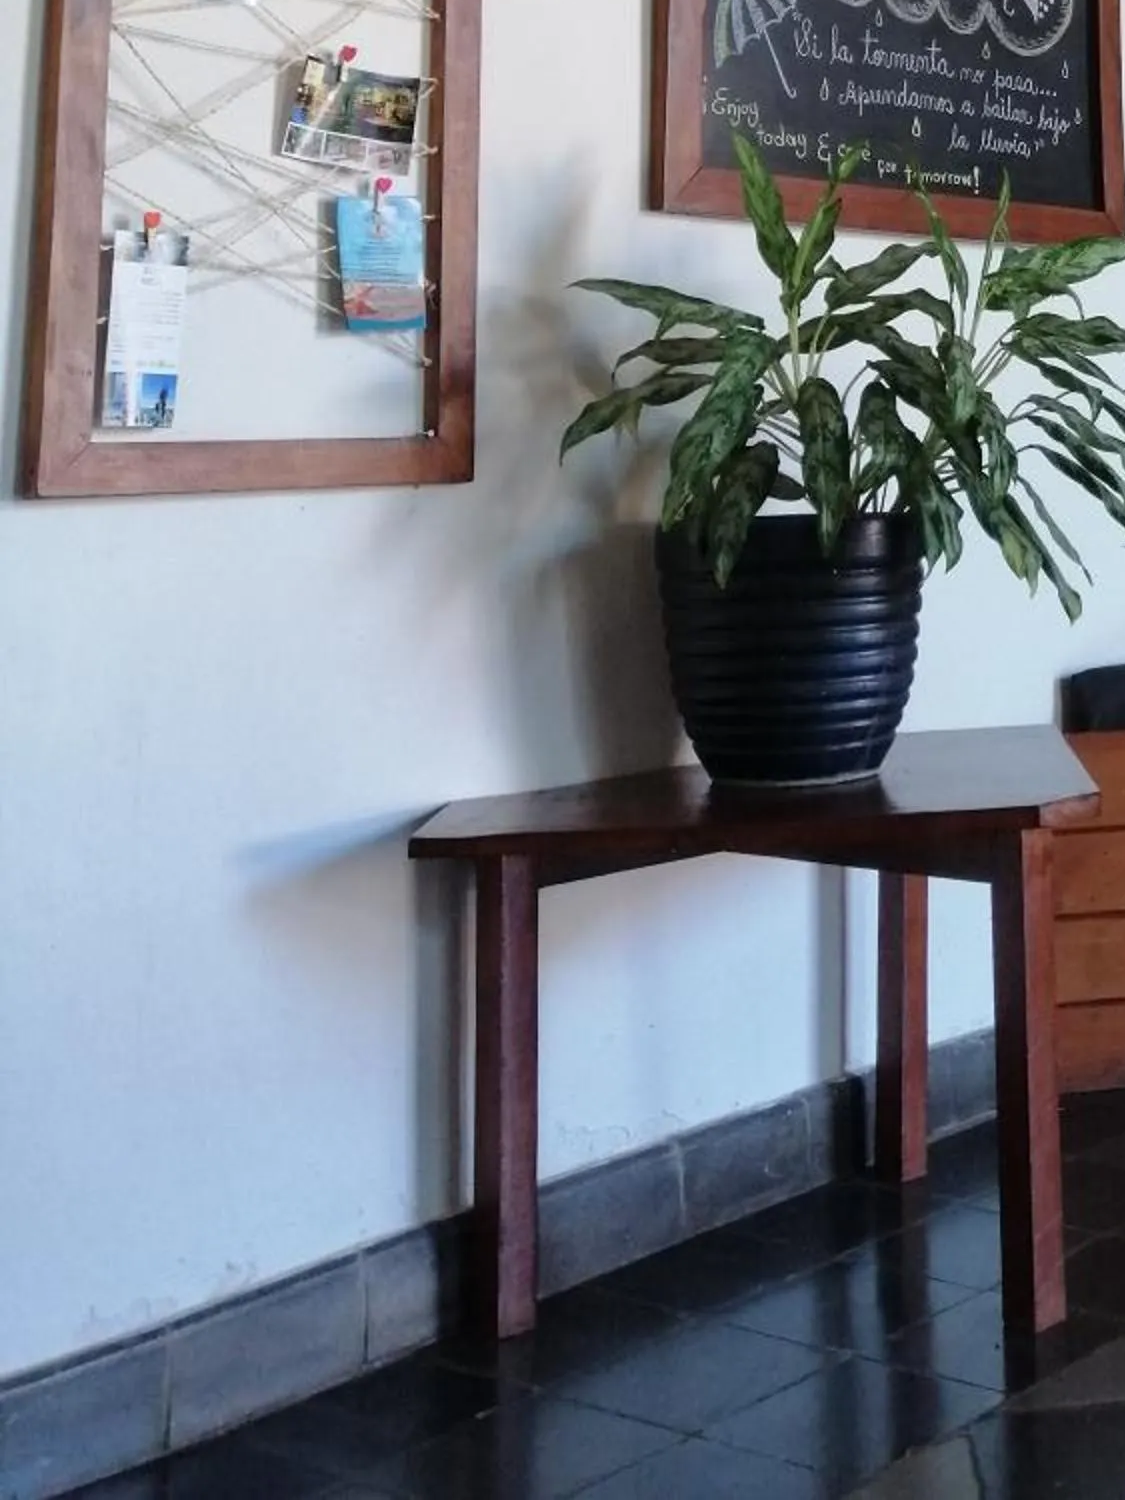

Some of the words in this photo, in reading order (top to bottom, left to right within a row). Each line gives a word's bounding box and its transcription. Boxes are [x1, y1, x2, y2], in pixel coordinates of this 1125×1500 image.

[829, 23, 853, 64] la
[859, 28, 955, 78] tormenta
[947, 122, 970, 151] la
[981, 90, 1033, 125] bailar
[1037, 103, 1071, 145] bajo
[755, 121, 807, 159] today
[903, 163, 980, 195] tmorrow!
